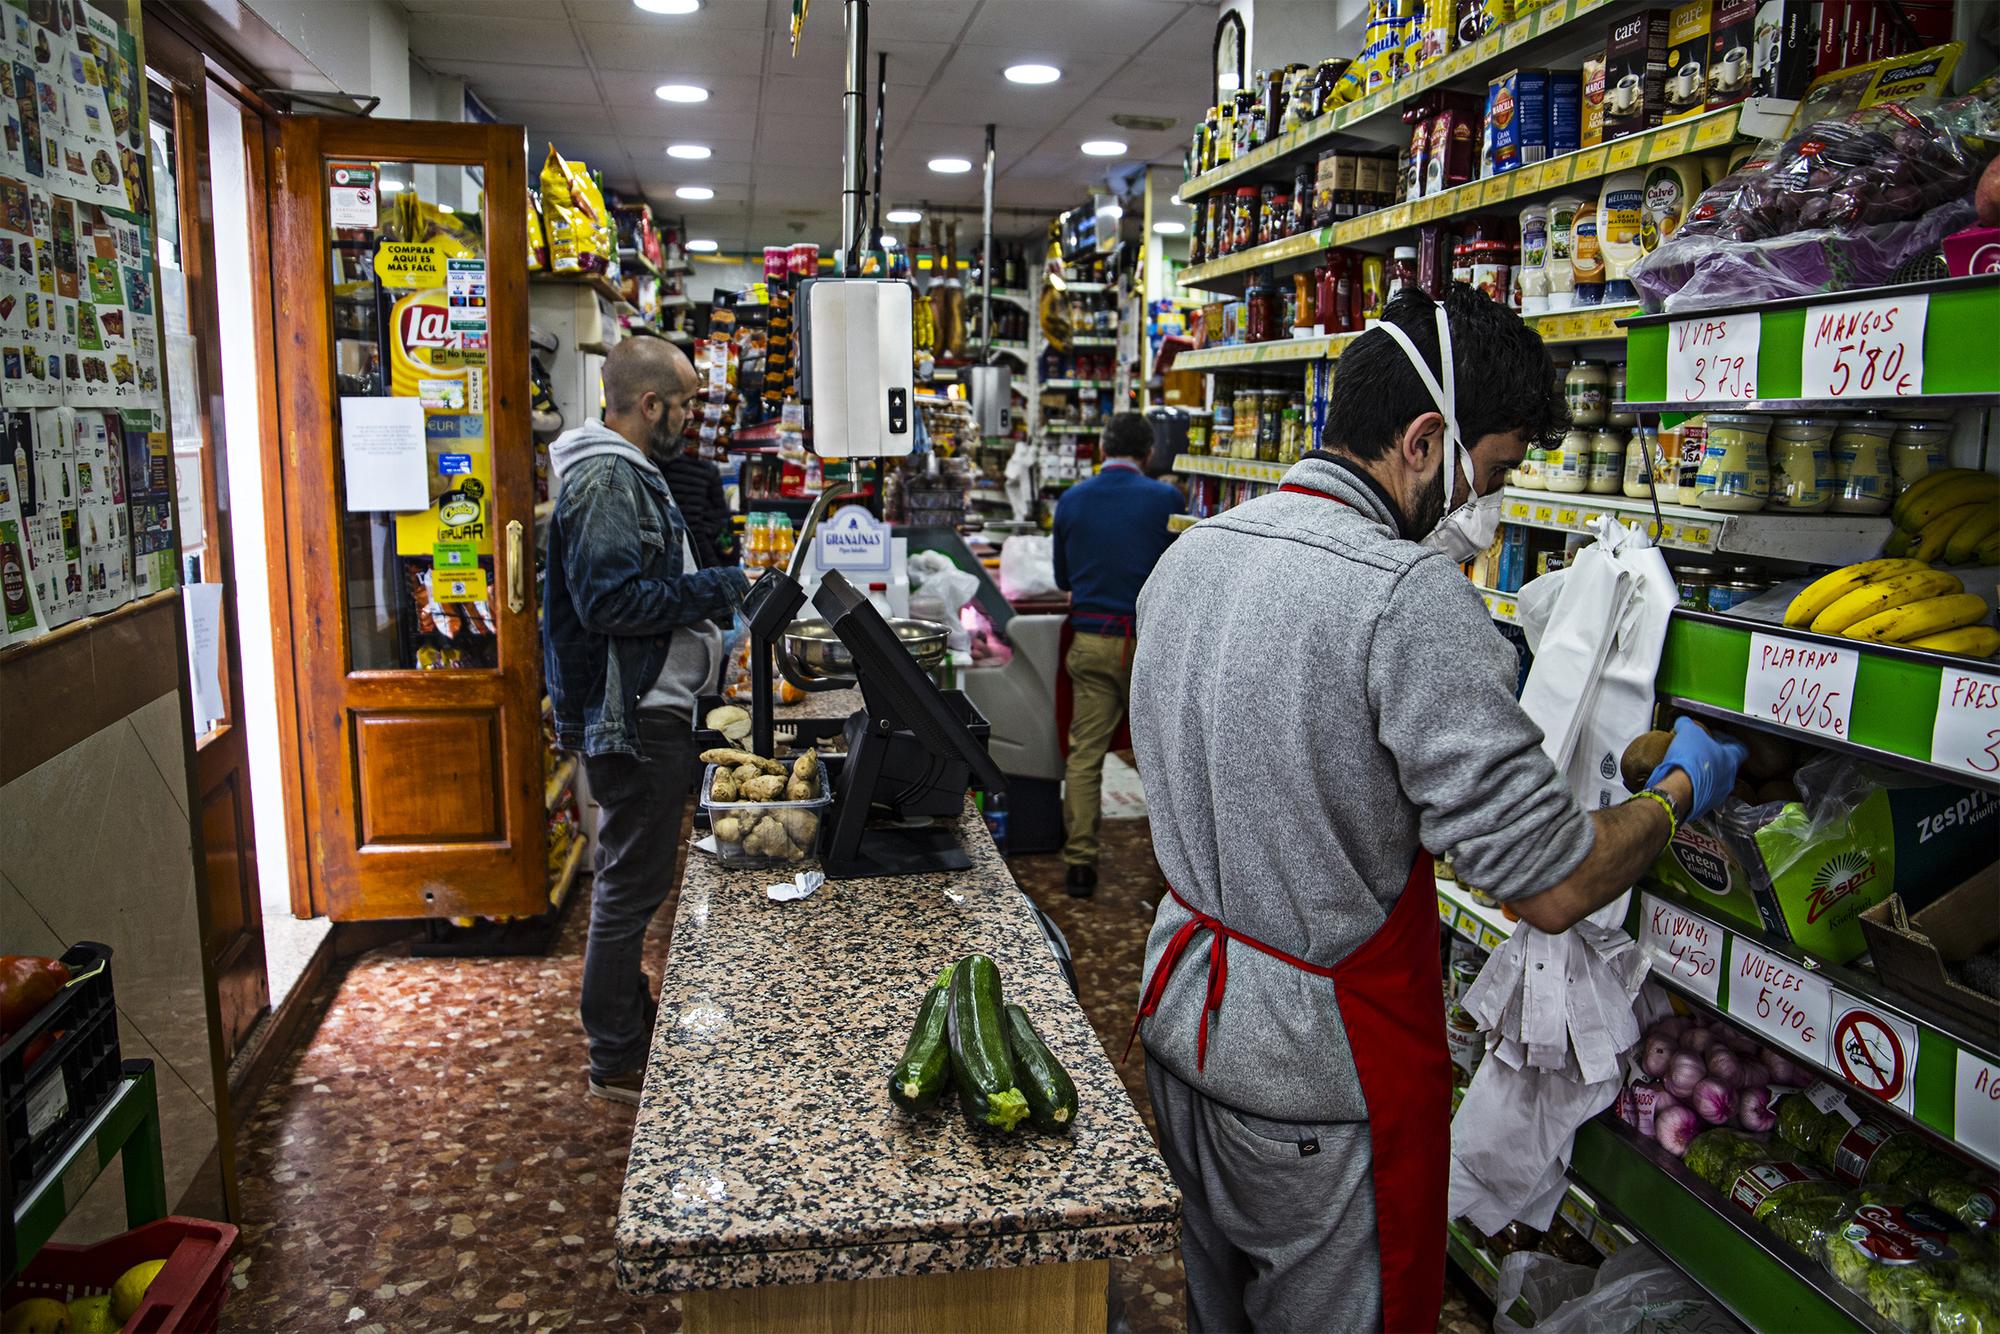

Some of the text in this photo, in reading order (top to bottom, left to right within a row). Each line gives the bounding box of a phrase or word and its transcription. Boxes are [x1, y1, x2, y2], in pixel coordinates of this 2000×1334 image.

[1875, 82, 1925, 100] Micro
[388, 245, 435, 254] COMPRAR
[420, 255, 431, 263] ES
[1814, 307, 1899, 348] MANGOS
[447, 350, 486, 358] No fumar
[1761, 644, 1839, 671] PLATANO
[1681, 847, 1719, 873] Green
[1686, 862, 1724, 885] Kiwifruit
[1805, 862, 1877, 925] Zespri
[1740, 952, 1805, 992] NUECES
